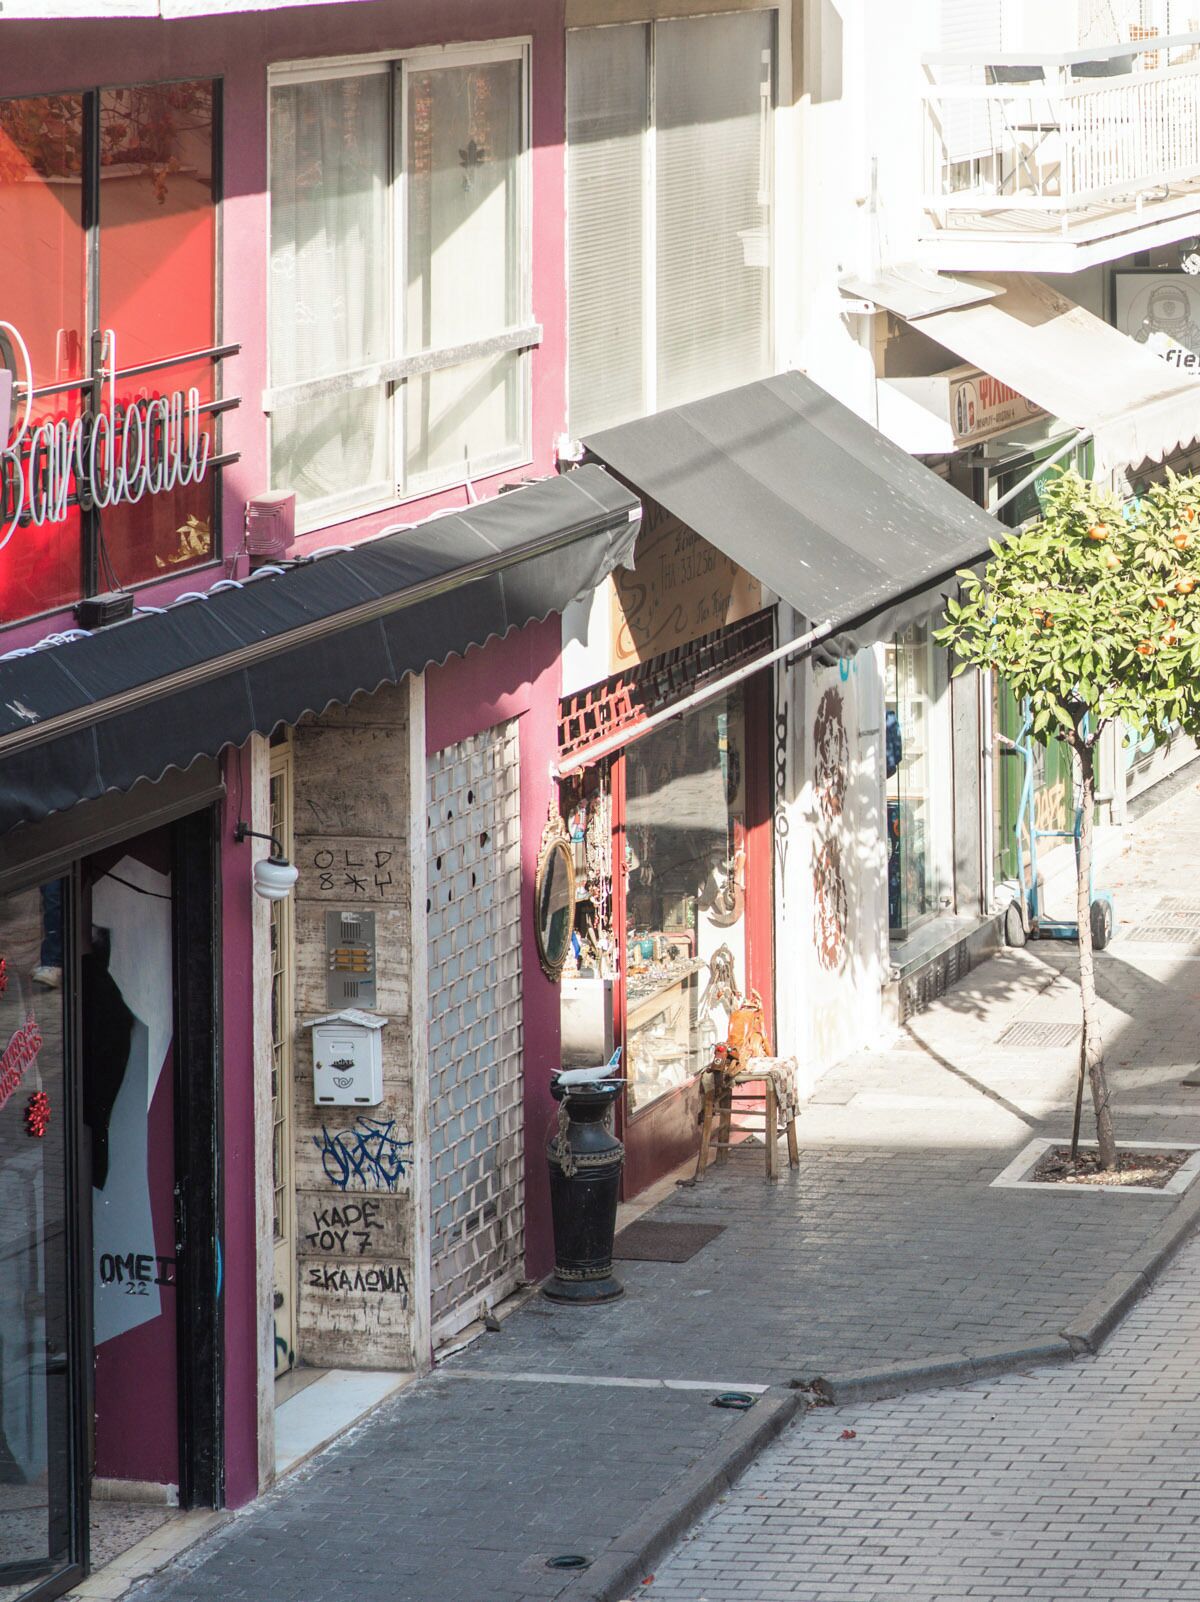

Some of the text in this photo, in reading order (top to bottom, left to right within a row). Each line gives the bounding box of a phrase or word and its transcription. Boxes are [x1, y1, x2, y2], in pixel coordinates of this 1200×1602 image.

[314, 850, 393, 869] OLD
[353, 1231, 372, 1254] 7
[125, 1281, 150, 1296] 22
